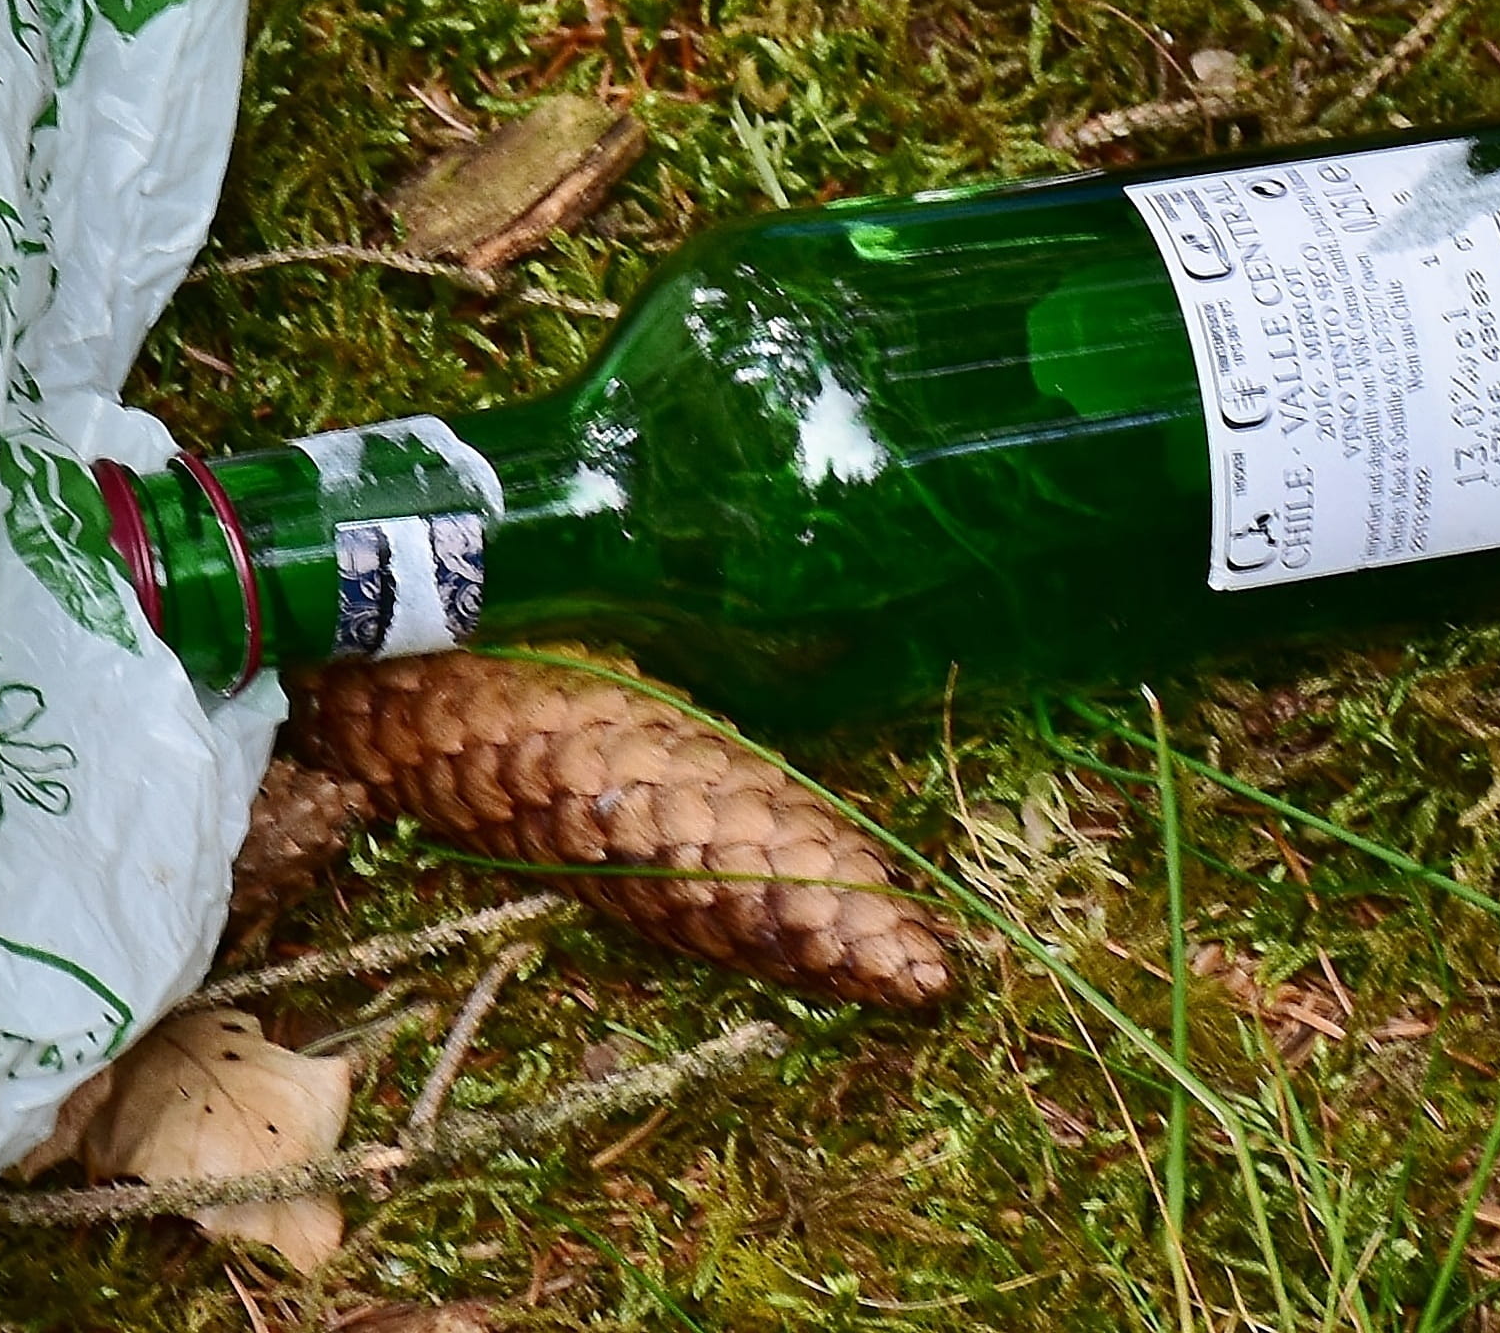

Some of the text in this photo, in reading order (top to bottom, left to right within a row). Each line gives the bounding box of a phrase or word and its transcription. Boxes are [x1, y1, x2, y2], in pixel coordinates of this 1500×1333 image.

[1205, 182, 1311, 567] CHILE VALLE CENTRAL
[1280, 263, 1337, 441] 2016 MERLOT
[1298, 241, 1361, 458] VINO TINTO SECO
[1383, 278, 1411, 322] Chile
[1399, 352, 1426, 392] Wein
